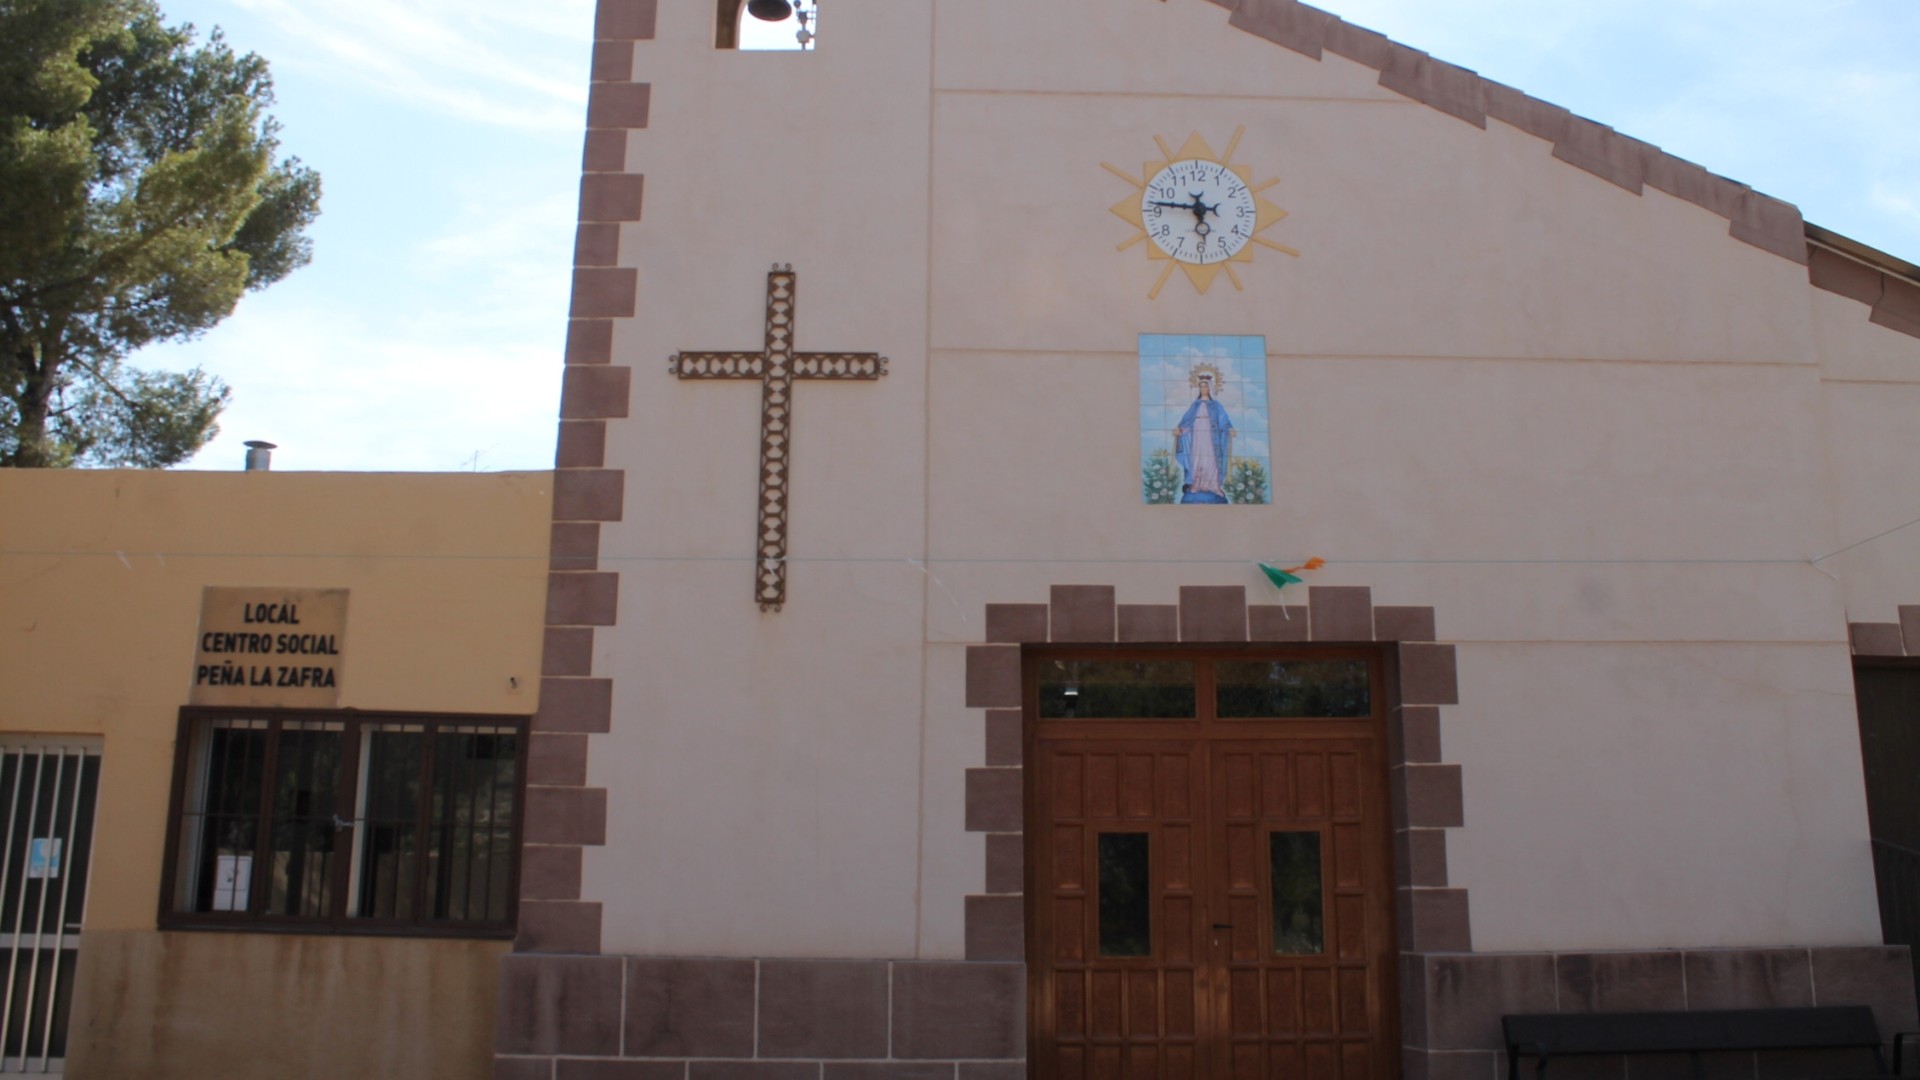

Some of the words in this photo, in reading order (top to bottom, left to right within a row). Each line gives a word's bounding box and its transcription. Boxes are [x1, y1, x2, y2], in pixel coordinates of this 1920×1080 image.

[1171, 175, 1187, 187] 11
[1189, 170, 1206, 182] 12
[1213, 175, 1220, 186] 1
[1158, 187, 1176, 199] 10
[1227, 187, 1237, 199] 2
[1153, 205, 1162, 218] 9
[1235, 206, 1245, 218] 3
[1161, 224, 1171, 236] 8
[1230, 224, 1240, 235] 4
[1176, 236, 1185, 248] 7
[1196, 241, 1206, 254] 6
[1217, 236, 1227, 248] 5
[243, 602, 300, 625] LOCAL
[201, 631, 273, 654] CENTRO
[276, 633, 339, 655] SOCIAL
[196, 659, 246, 686] PEÑA
[249, 665, 273, 687] LA
[276, 666, 336, 688] ZAFRA
